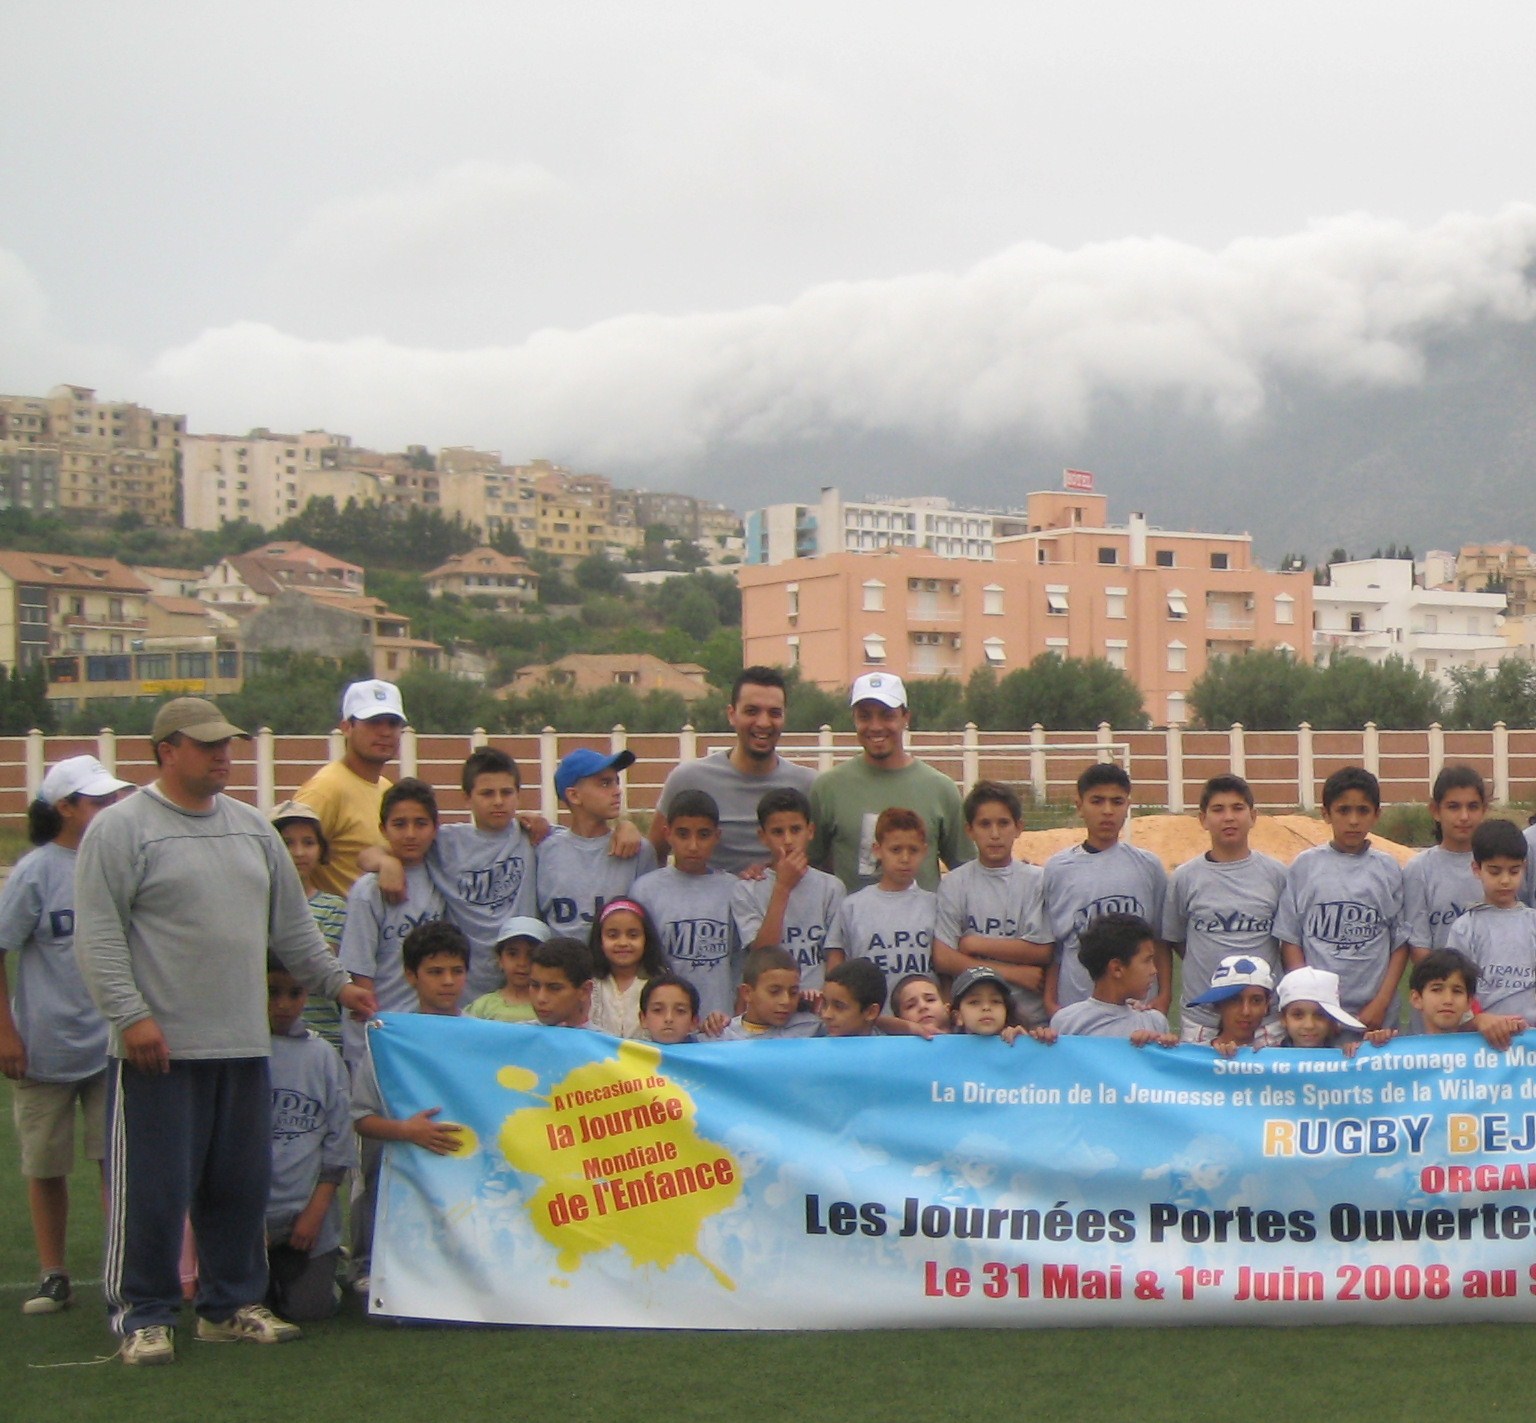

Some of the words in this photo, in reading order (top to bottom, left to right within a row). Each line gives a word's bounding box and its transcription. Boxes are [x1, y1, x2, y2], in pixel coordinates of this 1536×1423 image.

[664, 919, 729, 956] Mon
[1307, 902, 1379, 938] Mon
[1474, 1047, 1502, 1069] de
[554, 1095, 565, 1112] A
[566, 1078, 643, 1109] l'Occasion
[646, 1076, 666, 1089] de
[931, 1080, 956, 1102] La
[963, 1081, 1061, 1104] Direction
[1068, 1081, 1092, 1104] de
[1099, 1082, 1117, 1104] la
[1124, 1082, 1226, 1107] Jeunesse
[1231, 1088, 1254, 1107] et
[1259, 1084, 1296, 1107] des
[1302, 1083, 1374, 1110] Sports
[1380, 1081, 1406, 1103] de
[1412, 1079, 1432, 1102] la
[1438, 1078, 1513, 1105] Wilaya
[546, 1123, 576, 1151] la
[579, 1095, 684, 1144] Journée
[1263, 1113, 1432, 1158] RUGBY
[582, 1141, 678, 1181] Mondiale
[548, 1193, 590, 1227] de
[592, 1157, 735, 1216] l'Enfance
[805, 1194, 888, 1237] Les
[900, 1197, 1137, 1244] Journées
[1149, 1202, 1318, 1244] Portes
[923, 1261, 970, 1298] Le
[983, 1262, 1030, 1298] 31
[1042, 1263, 1122, 1300] Mai
[1133, 1269, 1165, 1300] &
[1233, 1265, 1325, 1301] Juin
[1336, 1264, 1451, 1300] 2008
[1462, 1267, 1517, 1298] au
